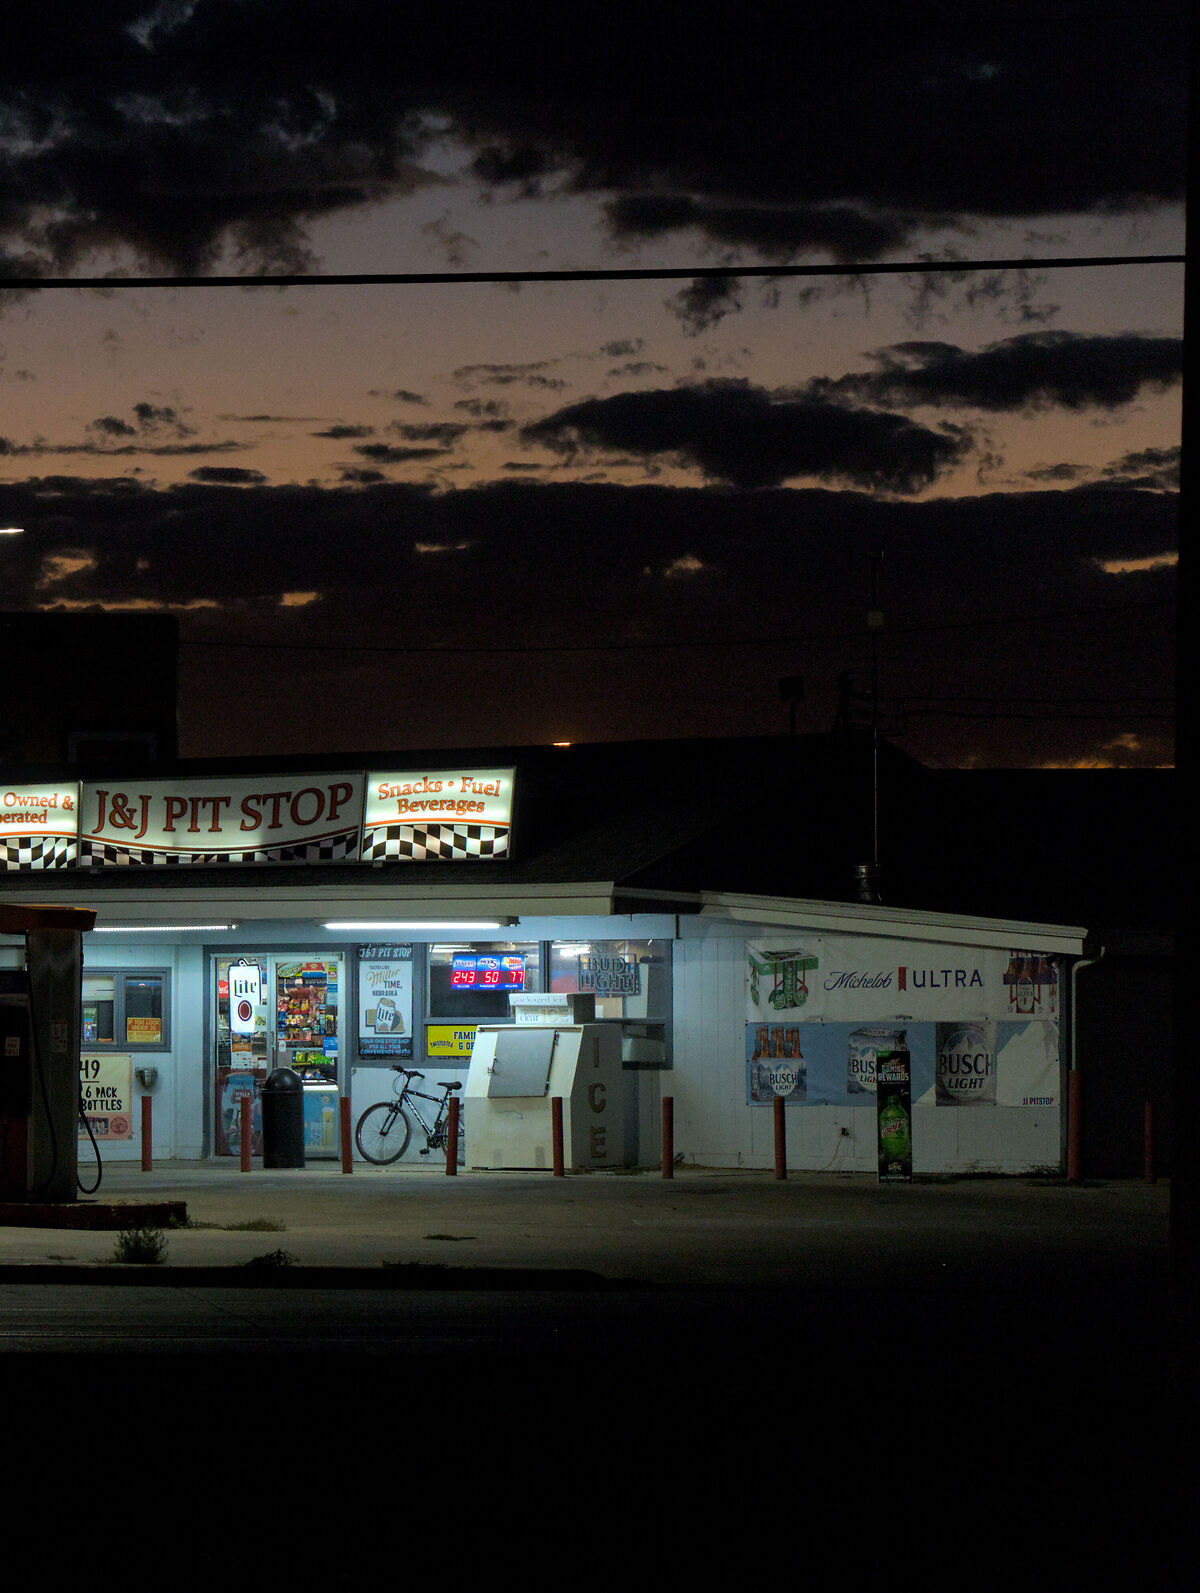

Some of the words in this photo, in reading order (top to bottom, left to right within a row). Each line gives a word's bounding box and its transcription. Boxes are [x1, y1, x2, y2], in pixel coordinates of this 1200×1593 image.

[378, 776, 443, 800] Snacks
[460, 776, 501, 797] Fuel
[6, 791, 58, 809] Owned
[61, 795, 75, 811] &
[397, 797, 485, 815] Beverages
[92, 789, 152, 839] J&J
[162, 795, 231, 832] PIT
[240, 782, 353, 832] STOP
[378, 948, 392, 957] PIT
[588, 956, 626, 973] BUD
[366, 968, 401, 988] Miller
[453, 971, 476, 983] 243
[485, 971, 499, 983] 50
[510, 971, 523, 982] 77
[581, 973, 632, 990] LIGHT
[824, 970, 896, 991] Michelob
[913, 969, 983, 988] ULTRA
[234, 979, 256, 998] Lite
[377, 1007, 394, 1021] Lite
[852, 1059, 875, 1074] BUS
[939, 1053, 994, 1076] BUSCH
[769, 1073, 798, 1085] BUSCH
[860, 1075, 877, 1083] LIGH
[878, 1073, 909, 1081] REWARDS
[947, 1078, 985, 1089] LIGHT
[85, 1086, 92, 1098] 6
[96, 1087, 118, 1098] PACK
[588, 1037, 607, 1159] ICE
[81, 1099, 123, 1111] BOTTLES
[1030, 1097, 1054, 1105] PITSTOP
